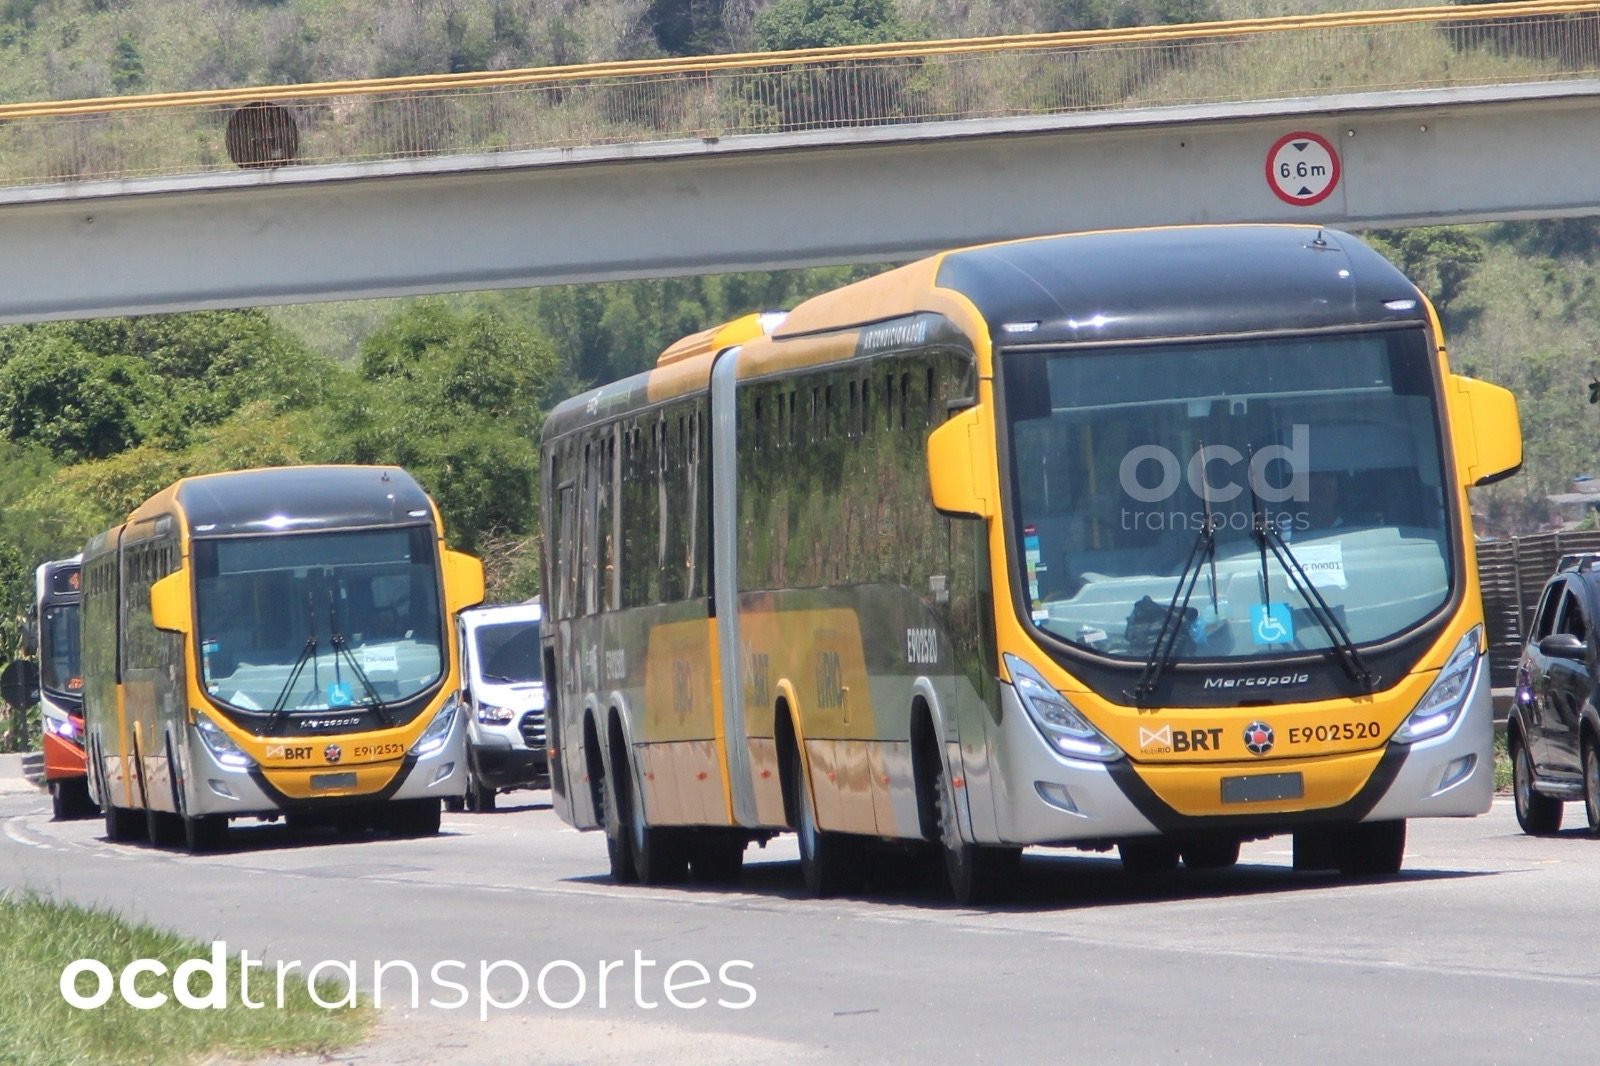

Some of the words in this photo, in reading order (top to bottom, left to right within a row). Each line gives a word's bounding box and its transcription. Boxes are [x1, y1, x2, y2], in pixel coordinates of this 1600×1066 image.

[1204, 673, 1309, 689] Marcopolo
[1172, 728, 1224, 752] BRT
[1288, 721, 1380, 744] E902520
[285, 747, 313, 760] BRT
[354, 744, 405, 757] E902521
